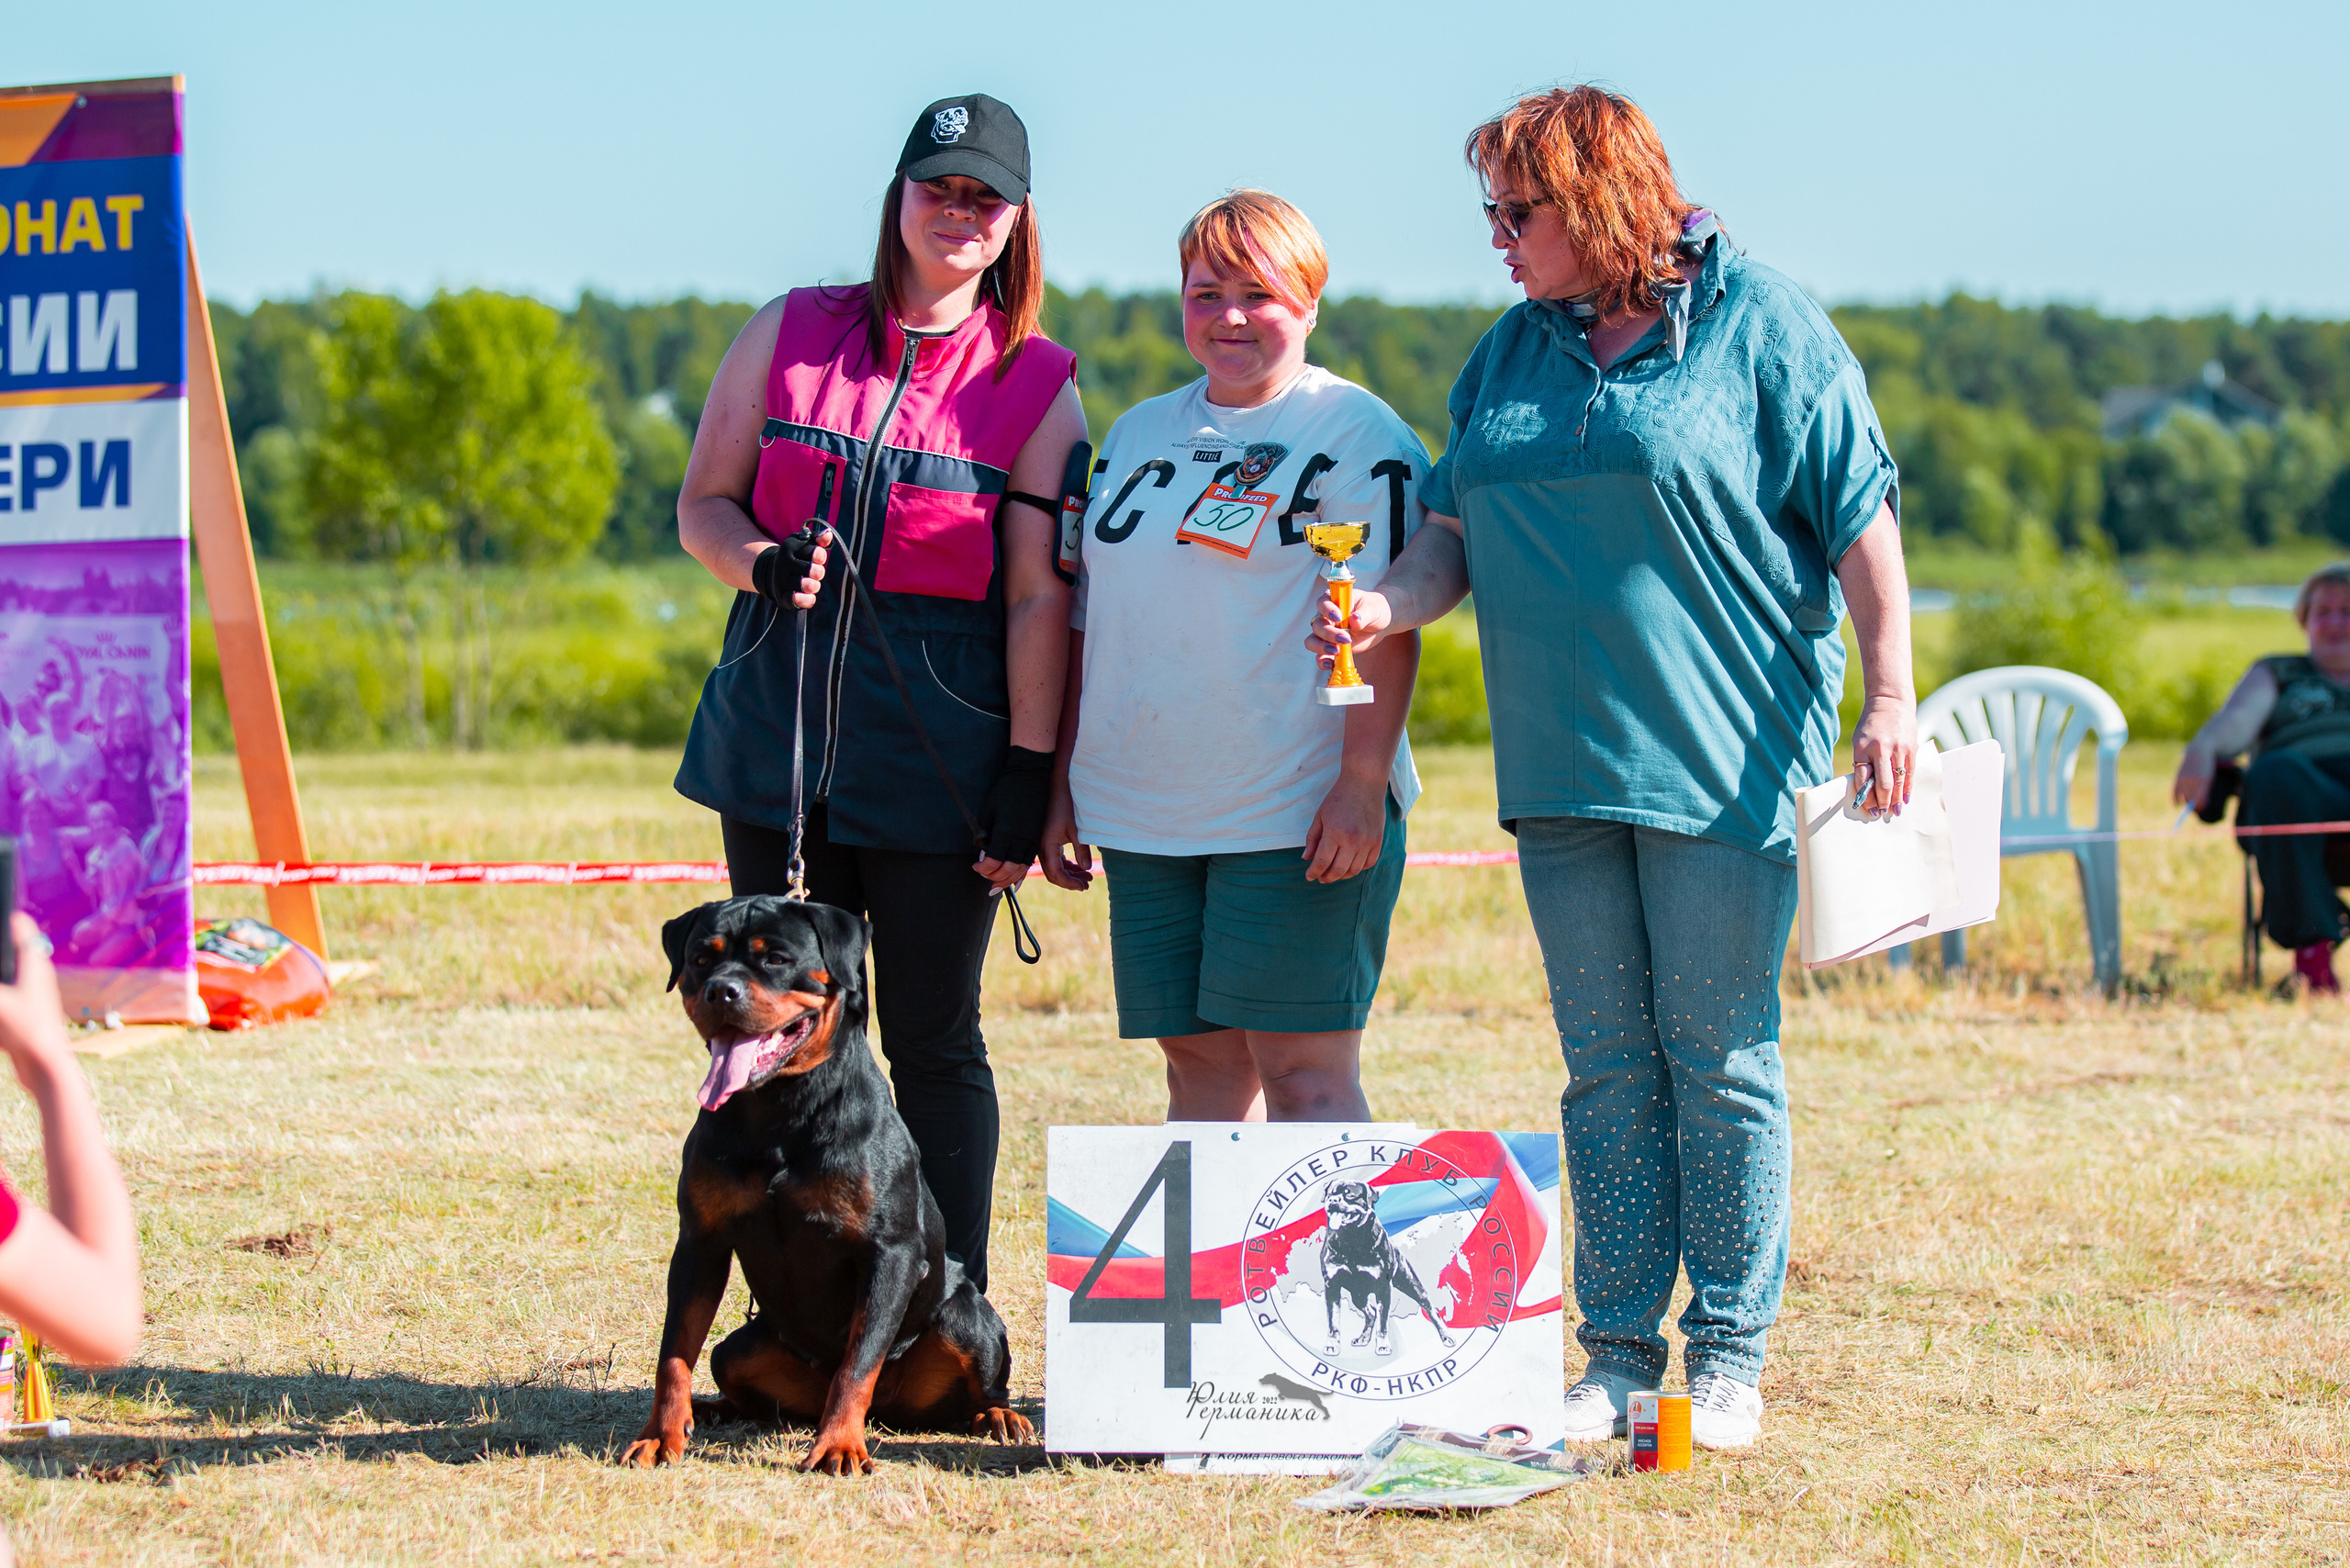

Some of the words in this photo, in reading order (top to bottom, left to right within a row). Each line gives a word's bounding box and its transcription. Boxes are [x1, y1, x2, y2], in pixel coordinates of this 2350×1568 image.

[0, 290, 139, 376] ИИ
[1068, 496, 1084, 509] PRO
[1213, 487, 1269, 502] PRIFEED
[1193, 503, 1255, 532] 50
[1246, 1149, 1349, 1328] РОТВЕЙЛЕР
[1371, 1145, 1461, 1187] КЛУБ
[1468, 1193, 1513, 1334] РОССИИ
[1069, 1140, 1222, 1389] 4
[1186, 1381, 1259, 1405] Юлия
[1261, 1395, 1278, 1405] 2022
[1311, 1358, 1458, 1396] РКФ-НКПР
[1186, 1395, 1320, 1440] Германика
[1216, 1452, 1259, 1462] Корма
